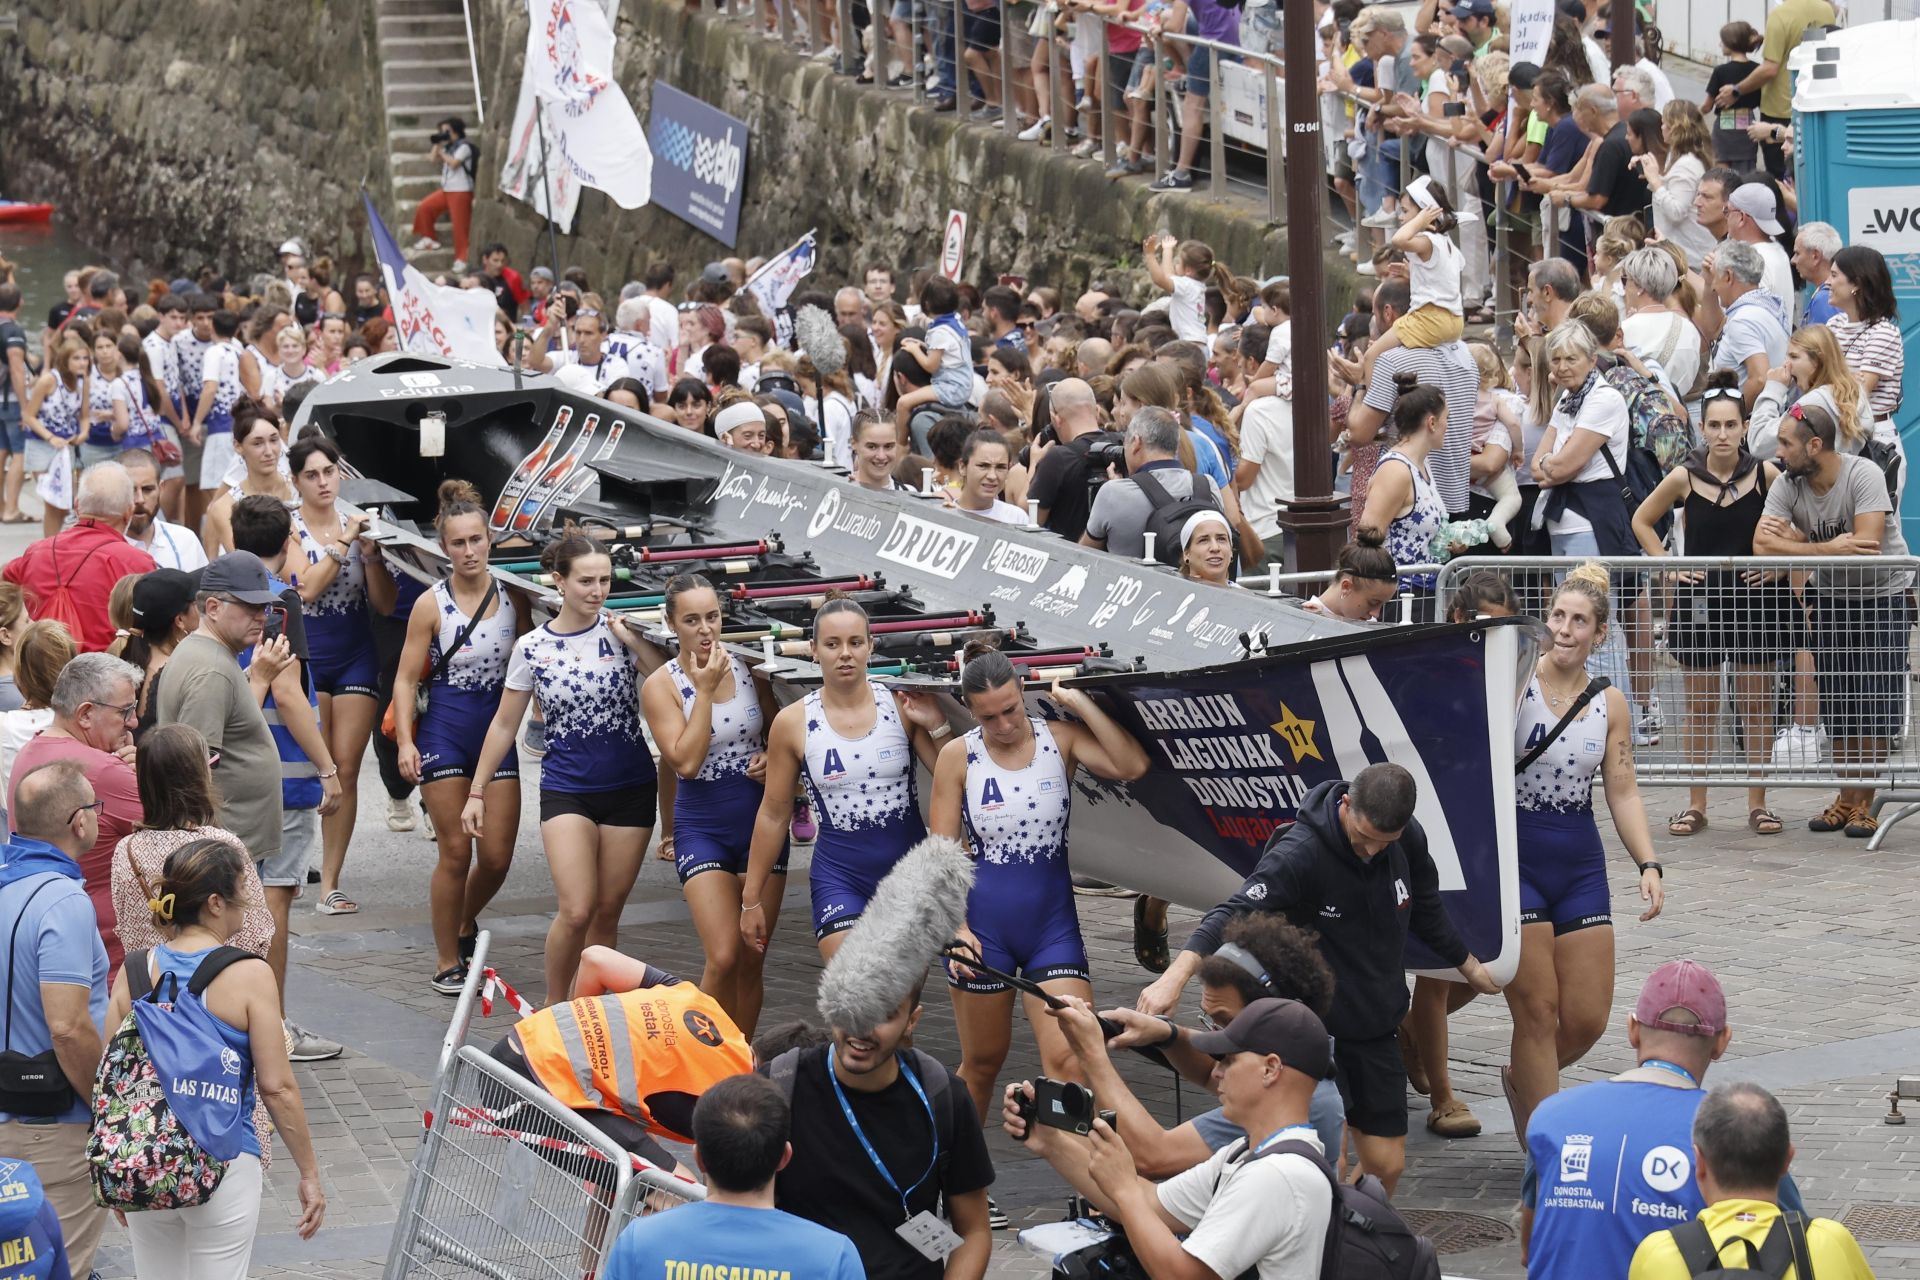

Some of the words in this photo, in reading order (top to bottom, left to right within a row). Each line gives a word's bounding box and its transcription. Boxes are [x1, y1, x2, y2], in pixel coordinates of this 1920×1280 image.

[1294, 122, 1305, 132] 02
[832, 502, 882, 541] Lurauto
[884, 519, 973, 573] DRUCK
[1001, 549, 1044, 577] EROSKI
[1192, 620, 1238, 647] OLATXO
[1133, 693, 1247, 730] ARRAUN
[1284, 724, 1309, 748] 11
[1157, 733, 1285, 770] LAGUNAK
[433, 768, 463, 777] DONOSTIA
[1182, 774, 1310, 809] DONOSTIA
[686, 862, 721, 877] DONOSTIA
[820, 904, 845, 923] amura
[1582, 914, 1608, 925] ARRAUN
[1047, 968, 1079, 977] ARRAUN
[967, 982, 1005, 991] DONOSTIA
[655, 999, 677, 1047] donostia
[583, 1029, 599, 1070] ACCESOS
[592, 1022, 610, 1080] KONTROLA
[172, 1078, 197, 1096] LAS
[201, 1081, 239, 1105] TATAS
[1544, 1197, 1558, 1208] SAN
[1558, 1198, 1605, 1211] SEBASTIÁN
[1553, 1186, 1593, 1197] DONOSTIA
[1631, 1198, 1688, 1221] festak
